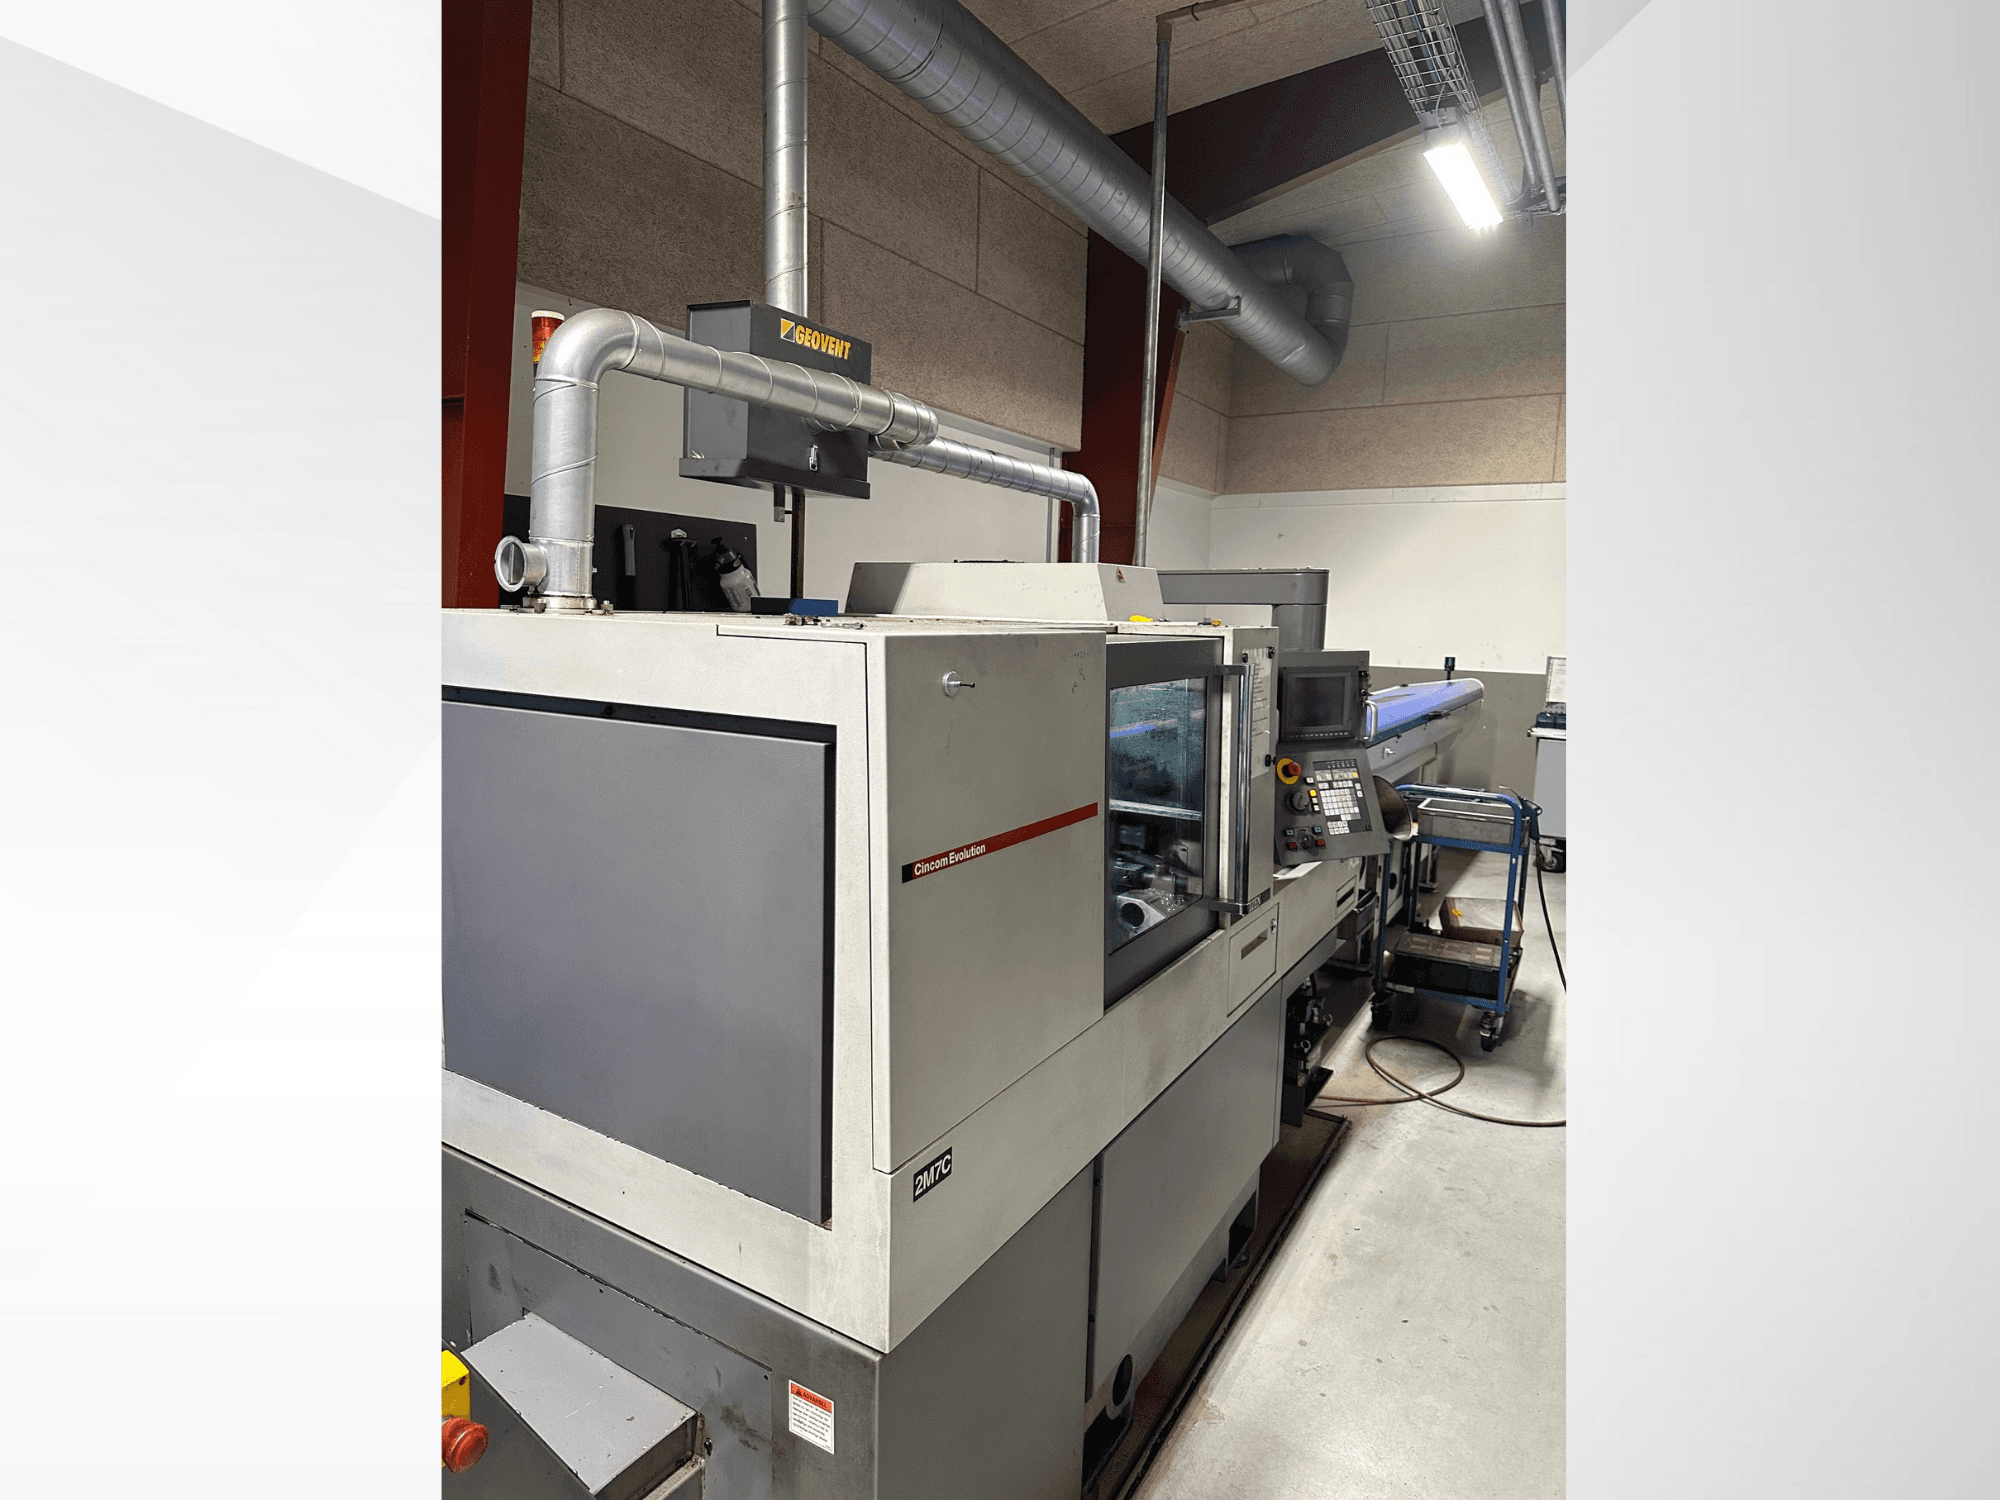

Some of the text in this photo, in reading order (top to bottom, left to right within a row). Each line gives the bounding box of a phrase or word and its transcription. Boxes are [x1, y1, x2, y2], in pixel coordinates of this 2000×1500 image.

[795, 324, 852, 360] GEOVENT
[914, 844, 986, 876] Cincom Evolution
[914, 1154, 952, 1197] 2M7C
